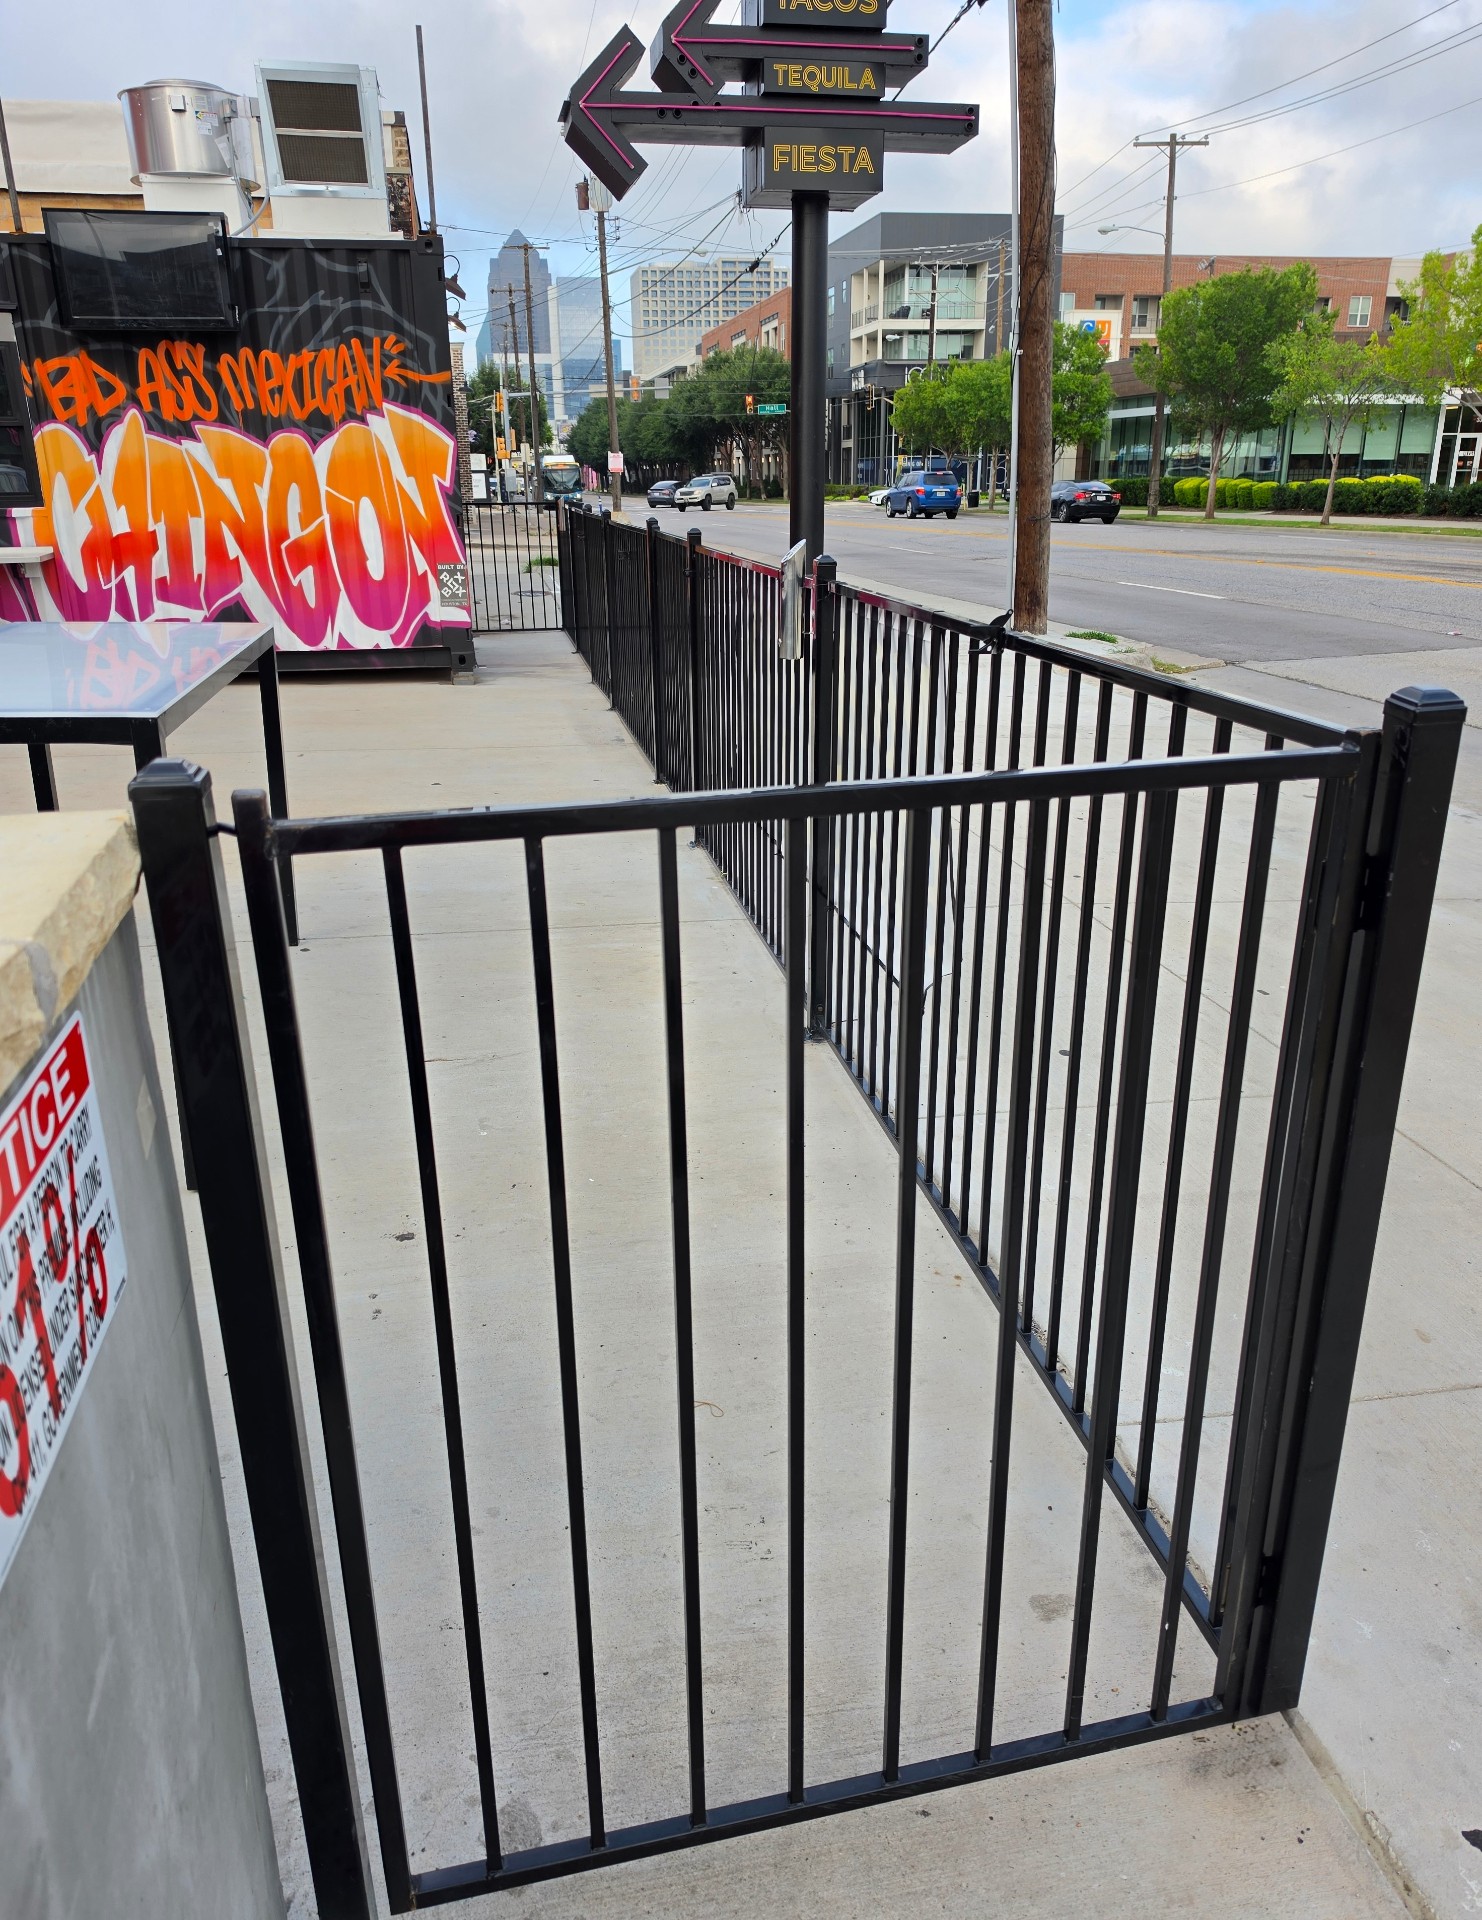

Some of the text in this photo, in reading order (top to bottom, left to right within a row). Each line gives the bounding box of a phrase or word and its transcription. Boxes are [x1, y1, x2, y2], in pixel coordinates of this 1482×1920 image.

[773, 63, 876, 91] TEQUILA
[773, 144, 875, 174] FIESTA
[136, 340, 218, 422] ASS
[20, 401, 470, 650] CHINGON
[0, 1047, 76, 1197] TICE
